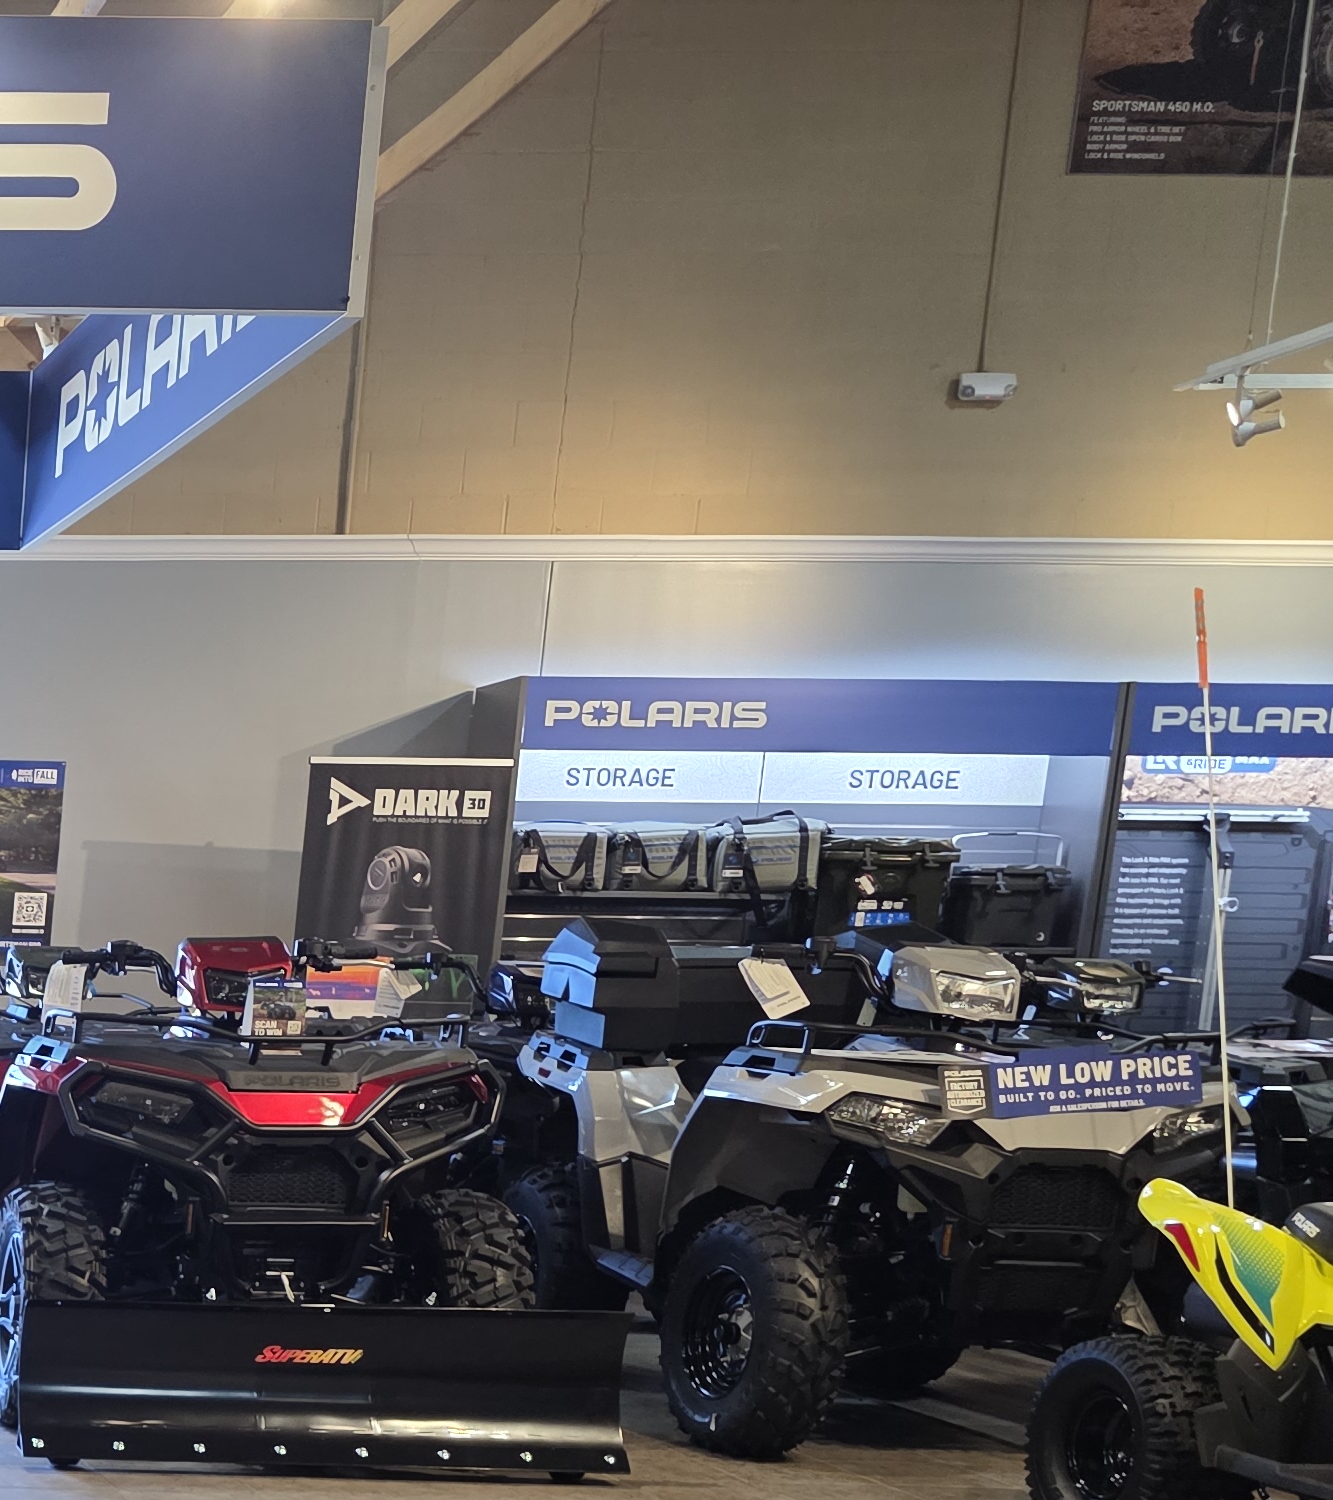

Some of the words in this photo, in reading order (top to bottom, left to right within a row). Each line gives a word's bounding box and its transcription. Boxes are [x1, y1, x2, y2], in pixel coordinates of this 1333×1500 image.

[1092, 100, 1165, 112] SPORTSMAN
[1167, 101, 1190, 112] 450
[1192, 102, 1215, 112] H.O.
[544, 700, 767, 728] POLARIS
[36, 770, 55, 780] FALL
[565, 767, 676, 787] STORAGE
[848, 769, 961, 790] STORAGE
[373, 788, 459, 816] DARK
[467, 798, 486, 809] 30
[254, 1028, 265, 1036] TO
[255, 1021, 277, 1029] SCAN
[244, 1074, 341, 1088] POLARIS
[997, 1065, 1052, 1089] NEW
[1059, 1060, 1112, 1085] LOW
[1120, 1055, 1193, 1080] PRICE
[998, 1093, 1033, 1104] BUILT
[1039, 1091, 1055, 1100] TO
[1085, 1085, 1131, 1098] PRICED
[1136, 1084, 1152, 1094] TO
[1157, 1081, 1195, 1093] MOVE.
[1292, 1212, 1321, 1238] POLARIS
